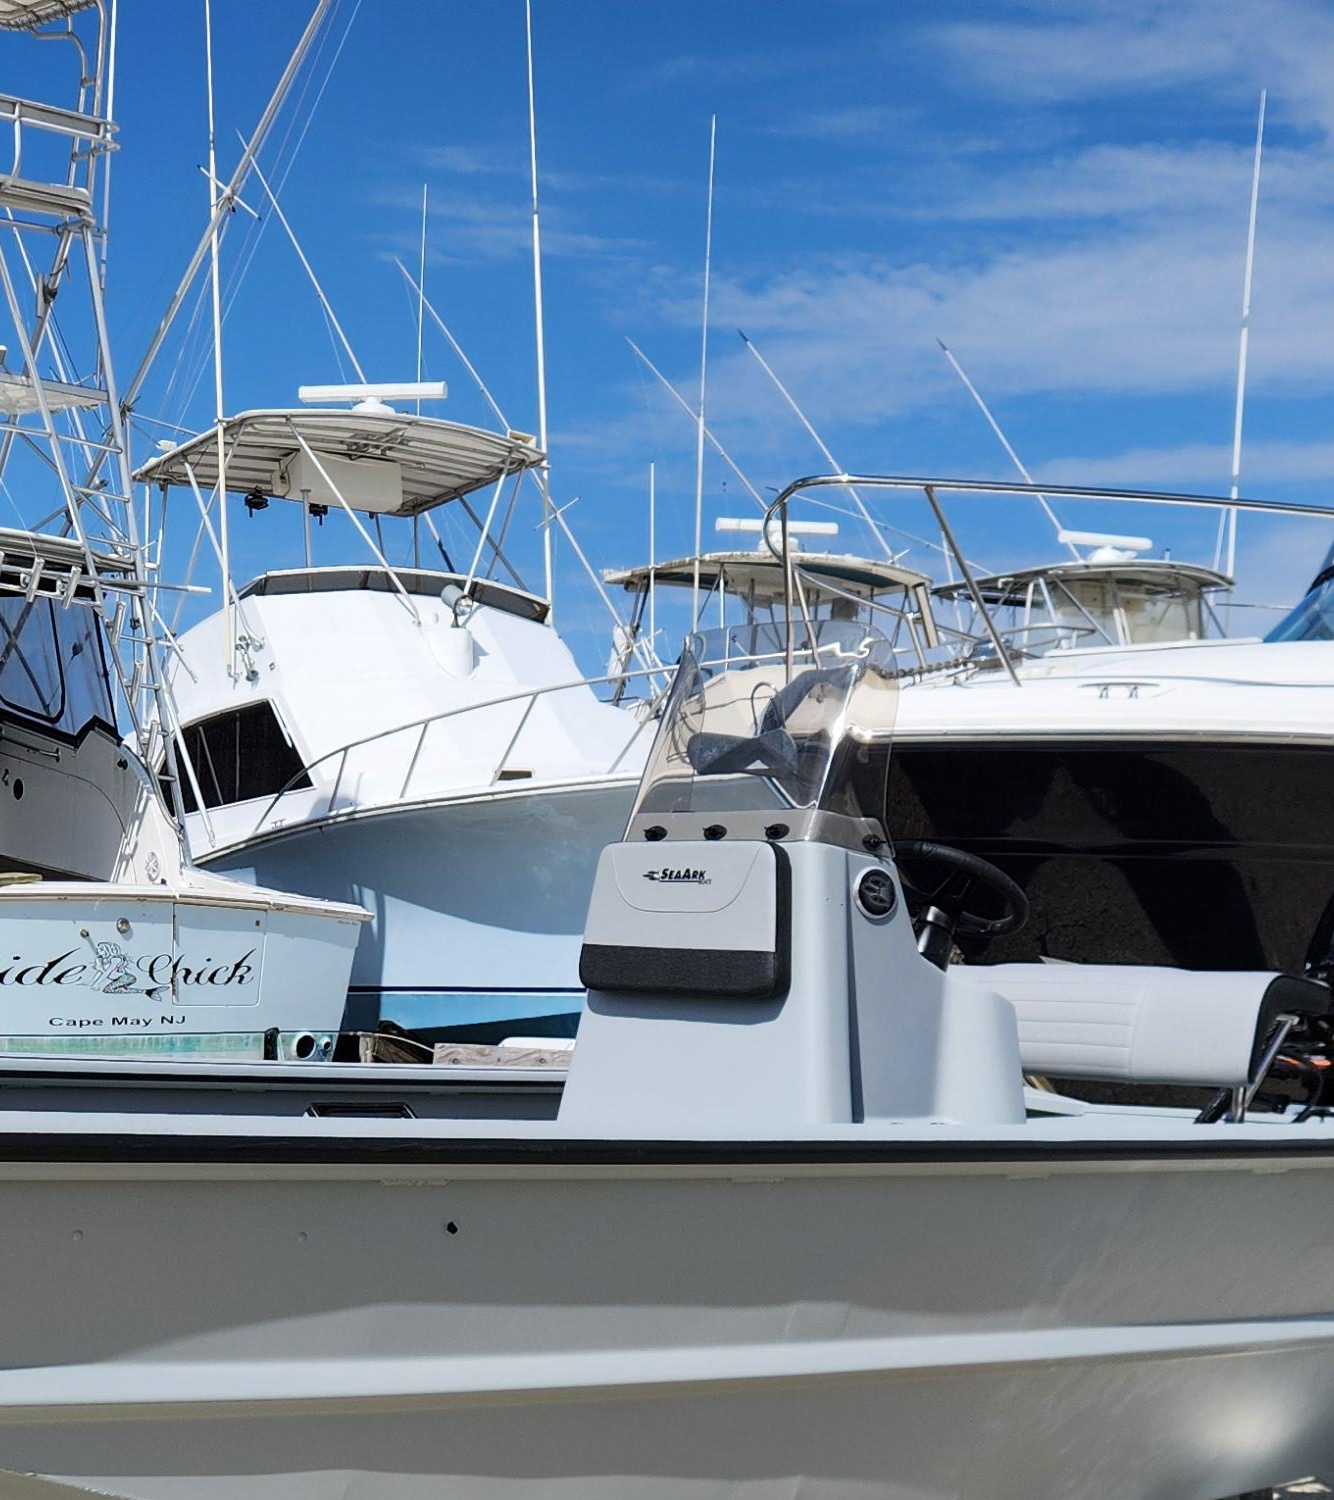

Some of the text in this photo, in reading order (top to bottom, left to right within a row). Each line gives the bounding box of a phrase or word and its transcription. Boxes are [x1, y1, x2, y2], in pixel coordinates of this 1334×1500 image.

[136, 947, 257, 986] Chick
[49, 1015, 186, 1028] Cape May NJ
